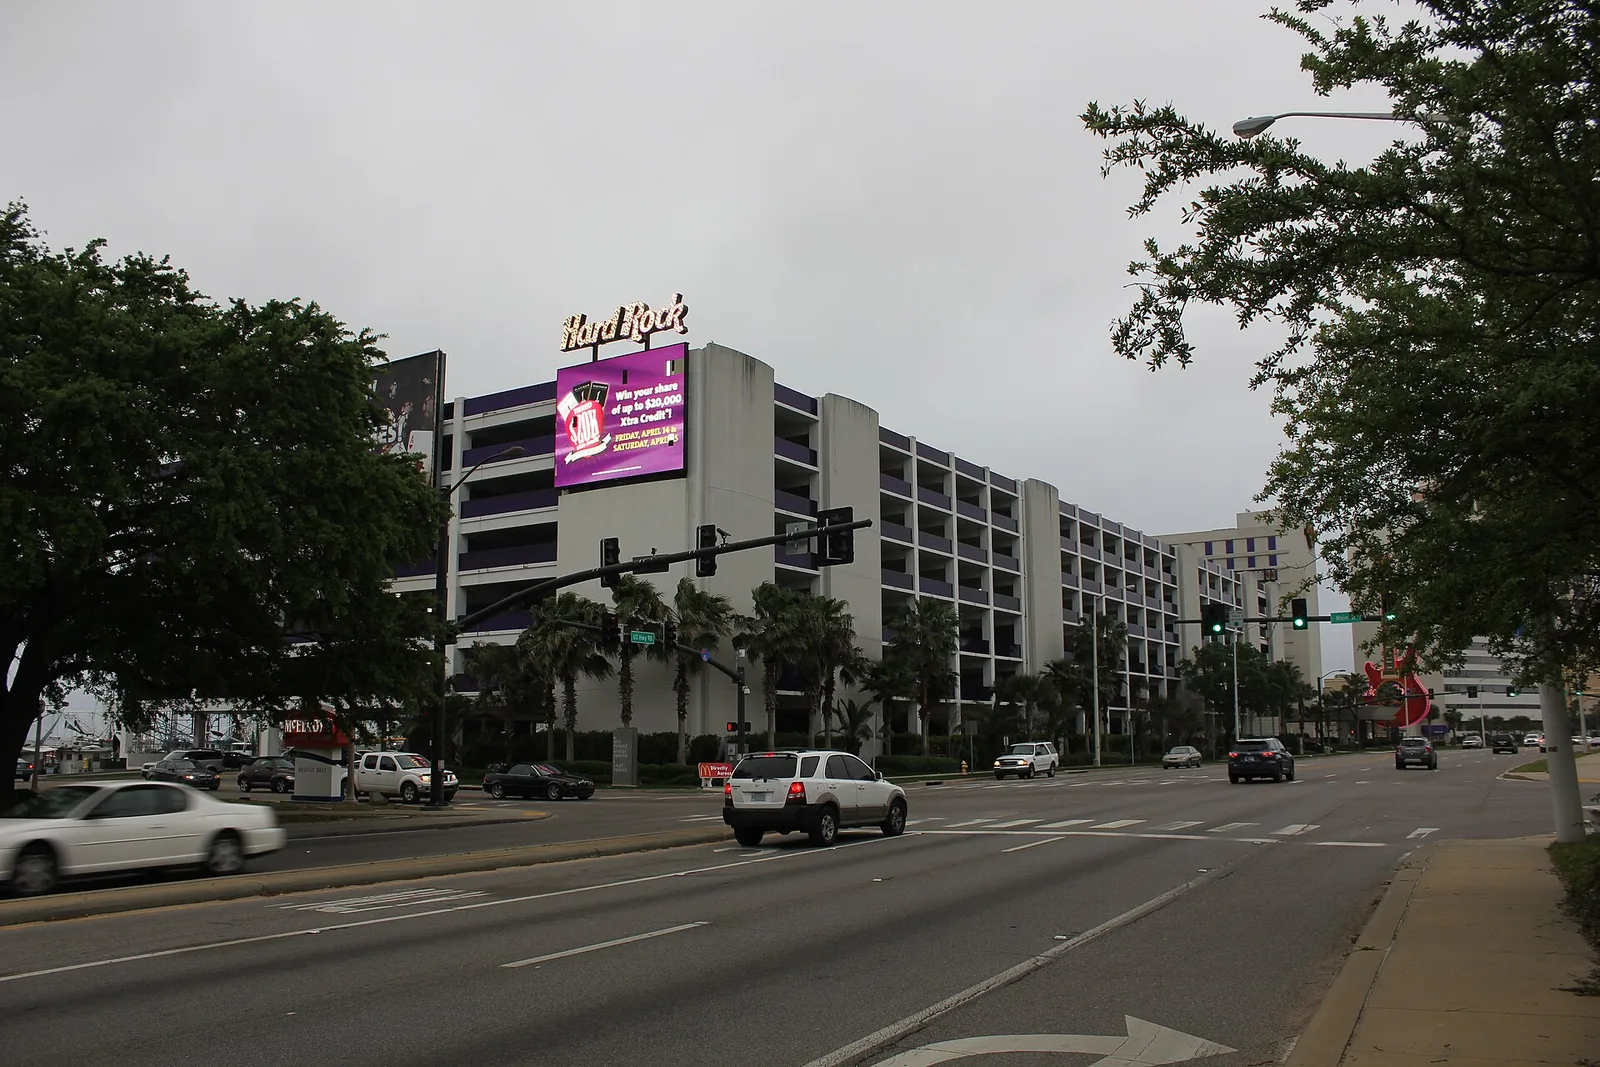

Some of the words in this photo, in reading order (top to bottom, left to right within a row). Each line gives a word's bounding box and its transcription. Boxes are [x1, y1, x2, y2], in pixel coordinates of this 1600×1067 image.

[560, 306, 624, 351] Hard
[621, 293, 688, 341] Rock
[615, 390, 633, 402] Win
[633, 385, 654, 401] your
[654, 382, 679, 395] share
[611, 403, 622, 416] of
[621, 404, 633, 415] up
[634, 401, 644, 411] to
[644, 393, 683, 411] $20,000
[619, 416, 639, 428] Xtra
[614, 430, 641, 443] FRIDAY,
[641, 427, 662, 438] APRIL
[612, 439, 650, 453] SATURDAY,
